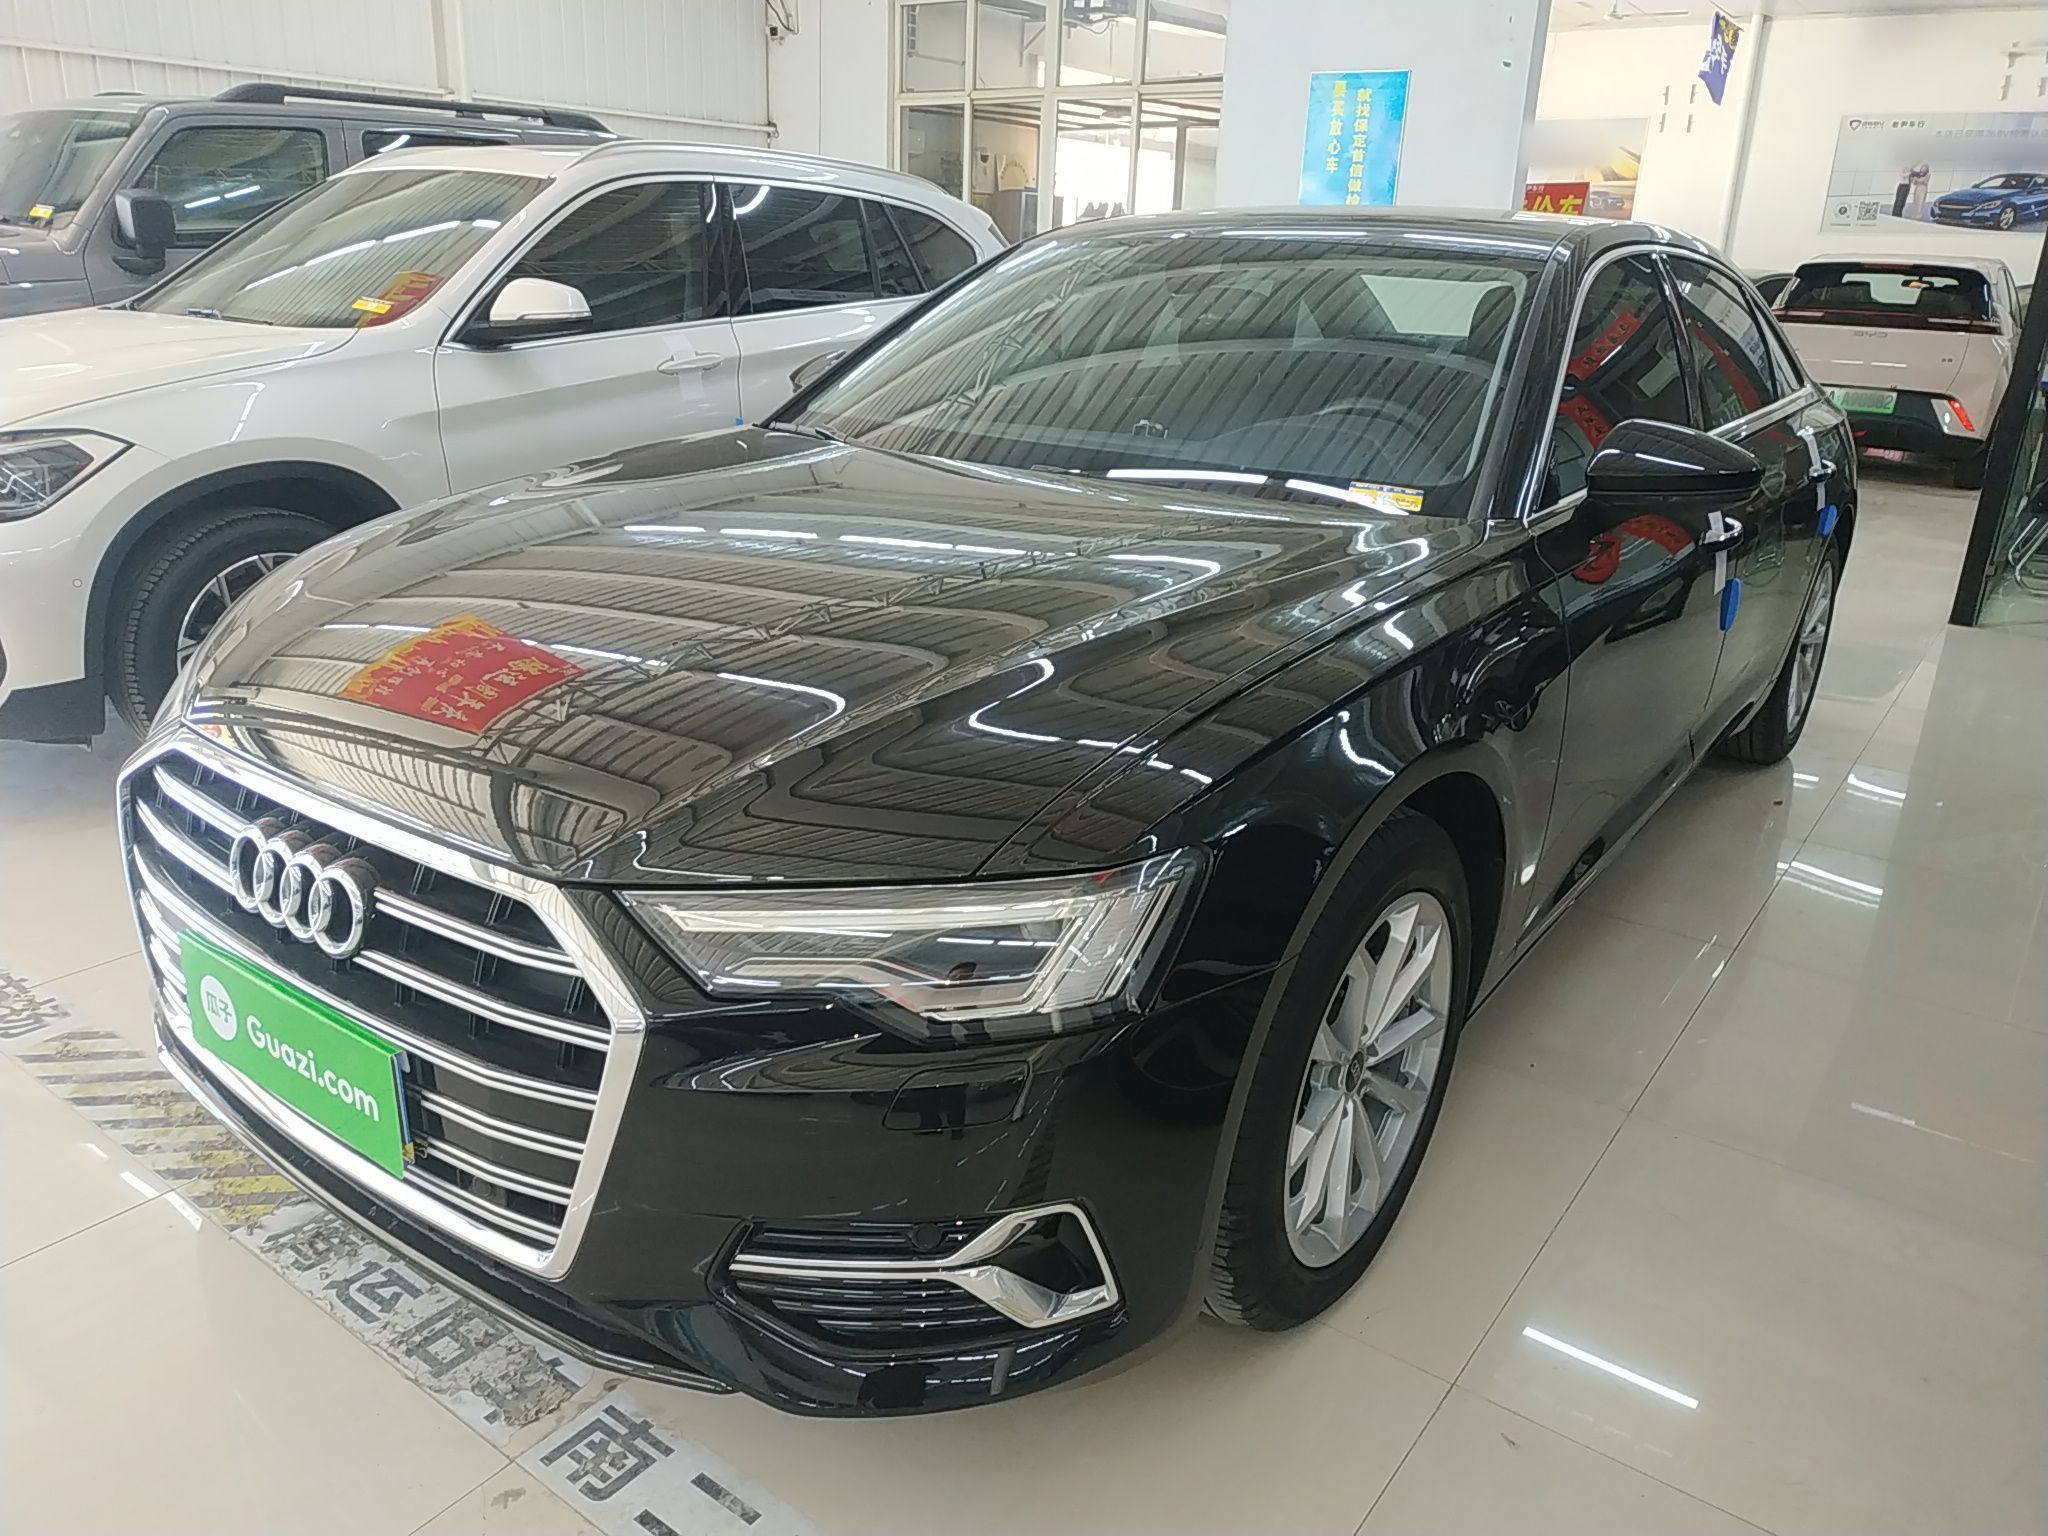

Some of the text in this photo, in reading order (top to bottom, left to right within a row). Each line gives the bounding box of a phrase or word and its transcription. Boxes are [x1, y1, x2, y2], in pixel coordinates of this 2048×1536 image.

[1325, 80, 1347, 174] 要买放心车
[1523, 194, 1583, 216] 价车
[1854, 330, 1888, 338] BYD
[206, 991, 233, 1024] 瓜子
[246, 1015, 380, 1122] Guazi.com
